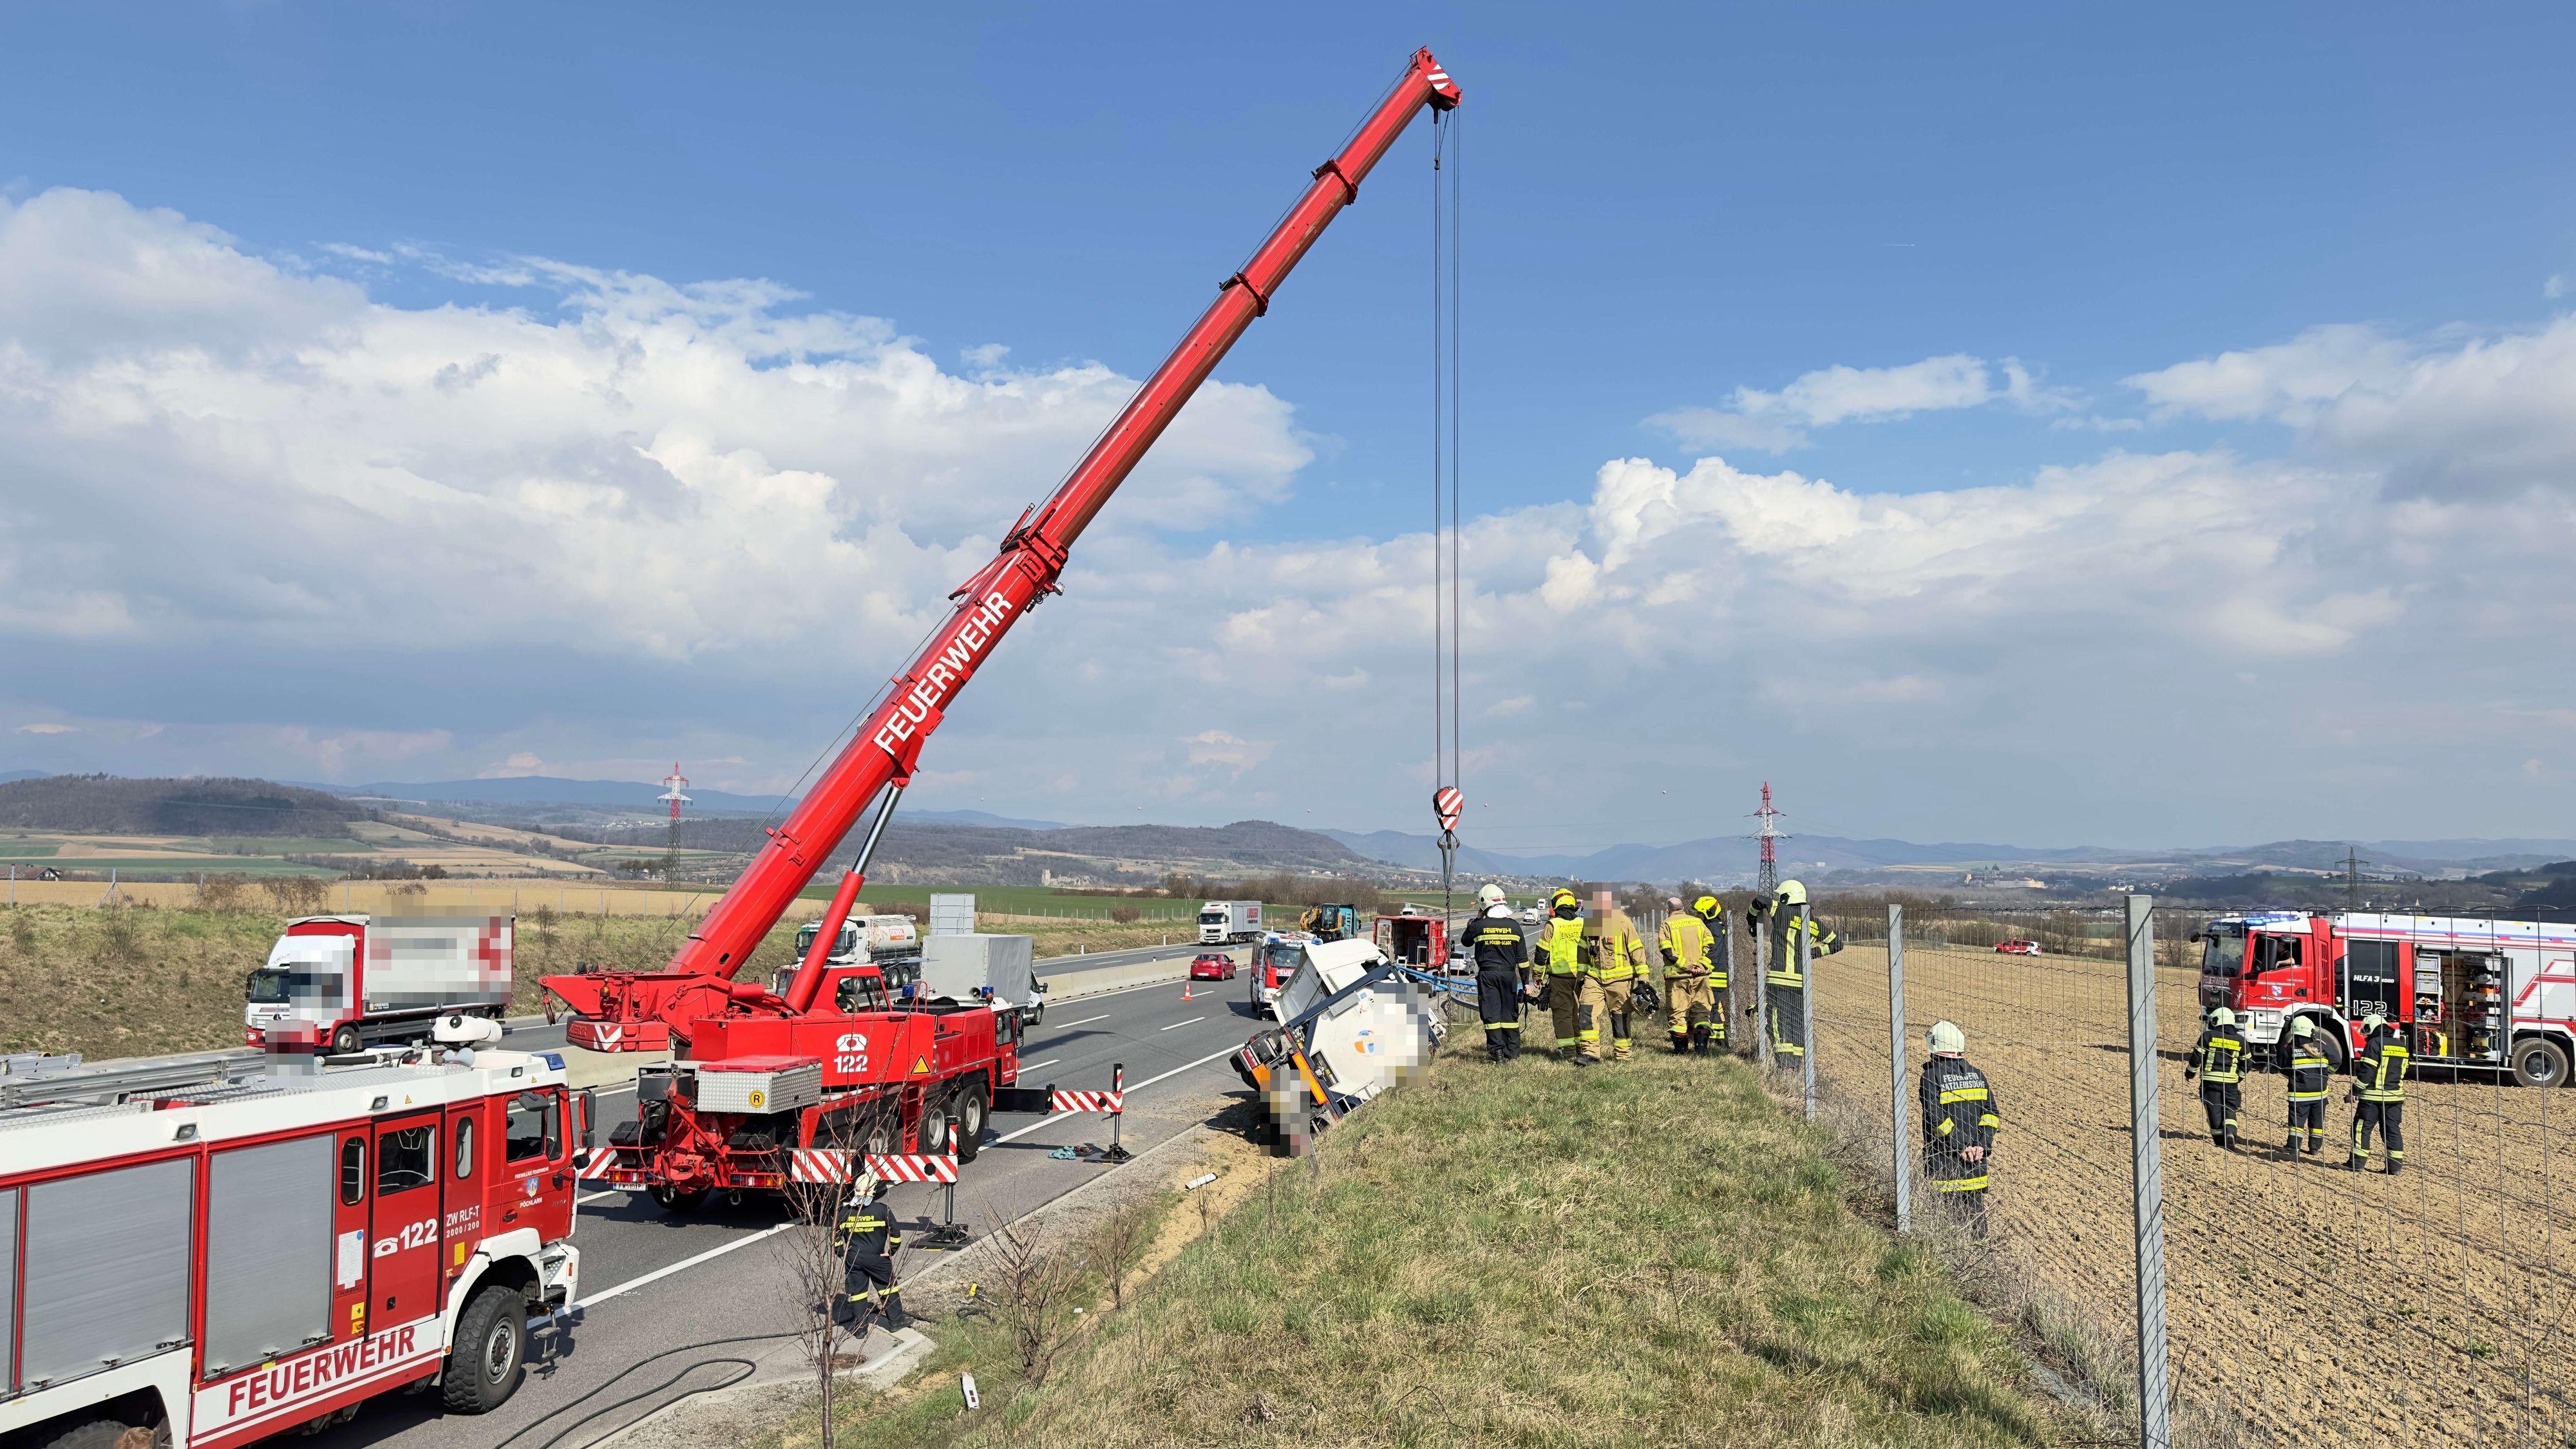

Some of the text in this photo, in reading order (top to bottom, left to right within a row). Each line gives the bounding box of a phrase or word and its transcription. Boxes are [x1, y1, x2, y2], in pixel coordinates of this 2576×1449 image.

[873, 591, 1012, 755] FEUERWEHR
[1561, 931, 1582, 940] EINSATZL
[2203, 976, 2230, 986] FEUERWEHR
[2353, 999, 2387, 1018] 122
[833, 1055, 868, 1074] 122
[1943, 1072, 1980, 1083] FEUERWEHR
[753, 1095, 760, 1103] R
[515, 1166, 549, 1179] FREIWILLIGE FEUERWEHR
[520, 1197, 542, 1208] PÖCHLARN
[446, 1205, 480, 1227] ZW RLF-T
[400, 1218, 438, 1250] 122
[446, 1226, 463, 1238] 2000
[468, 1220, 480, 1231] 200
[228, 1325, 415, 1417] FEUERWEHR
